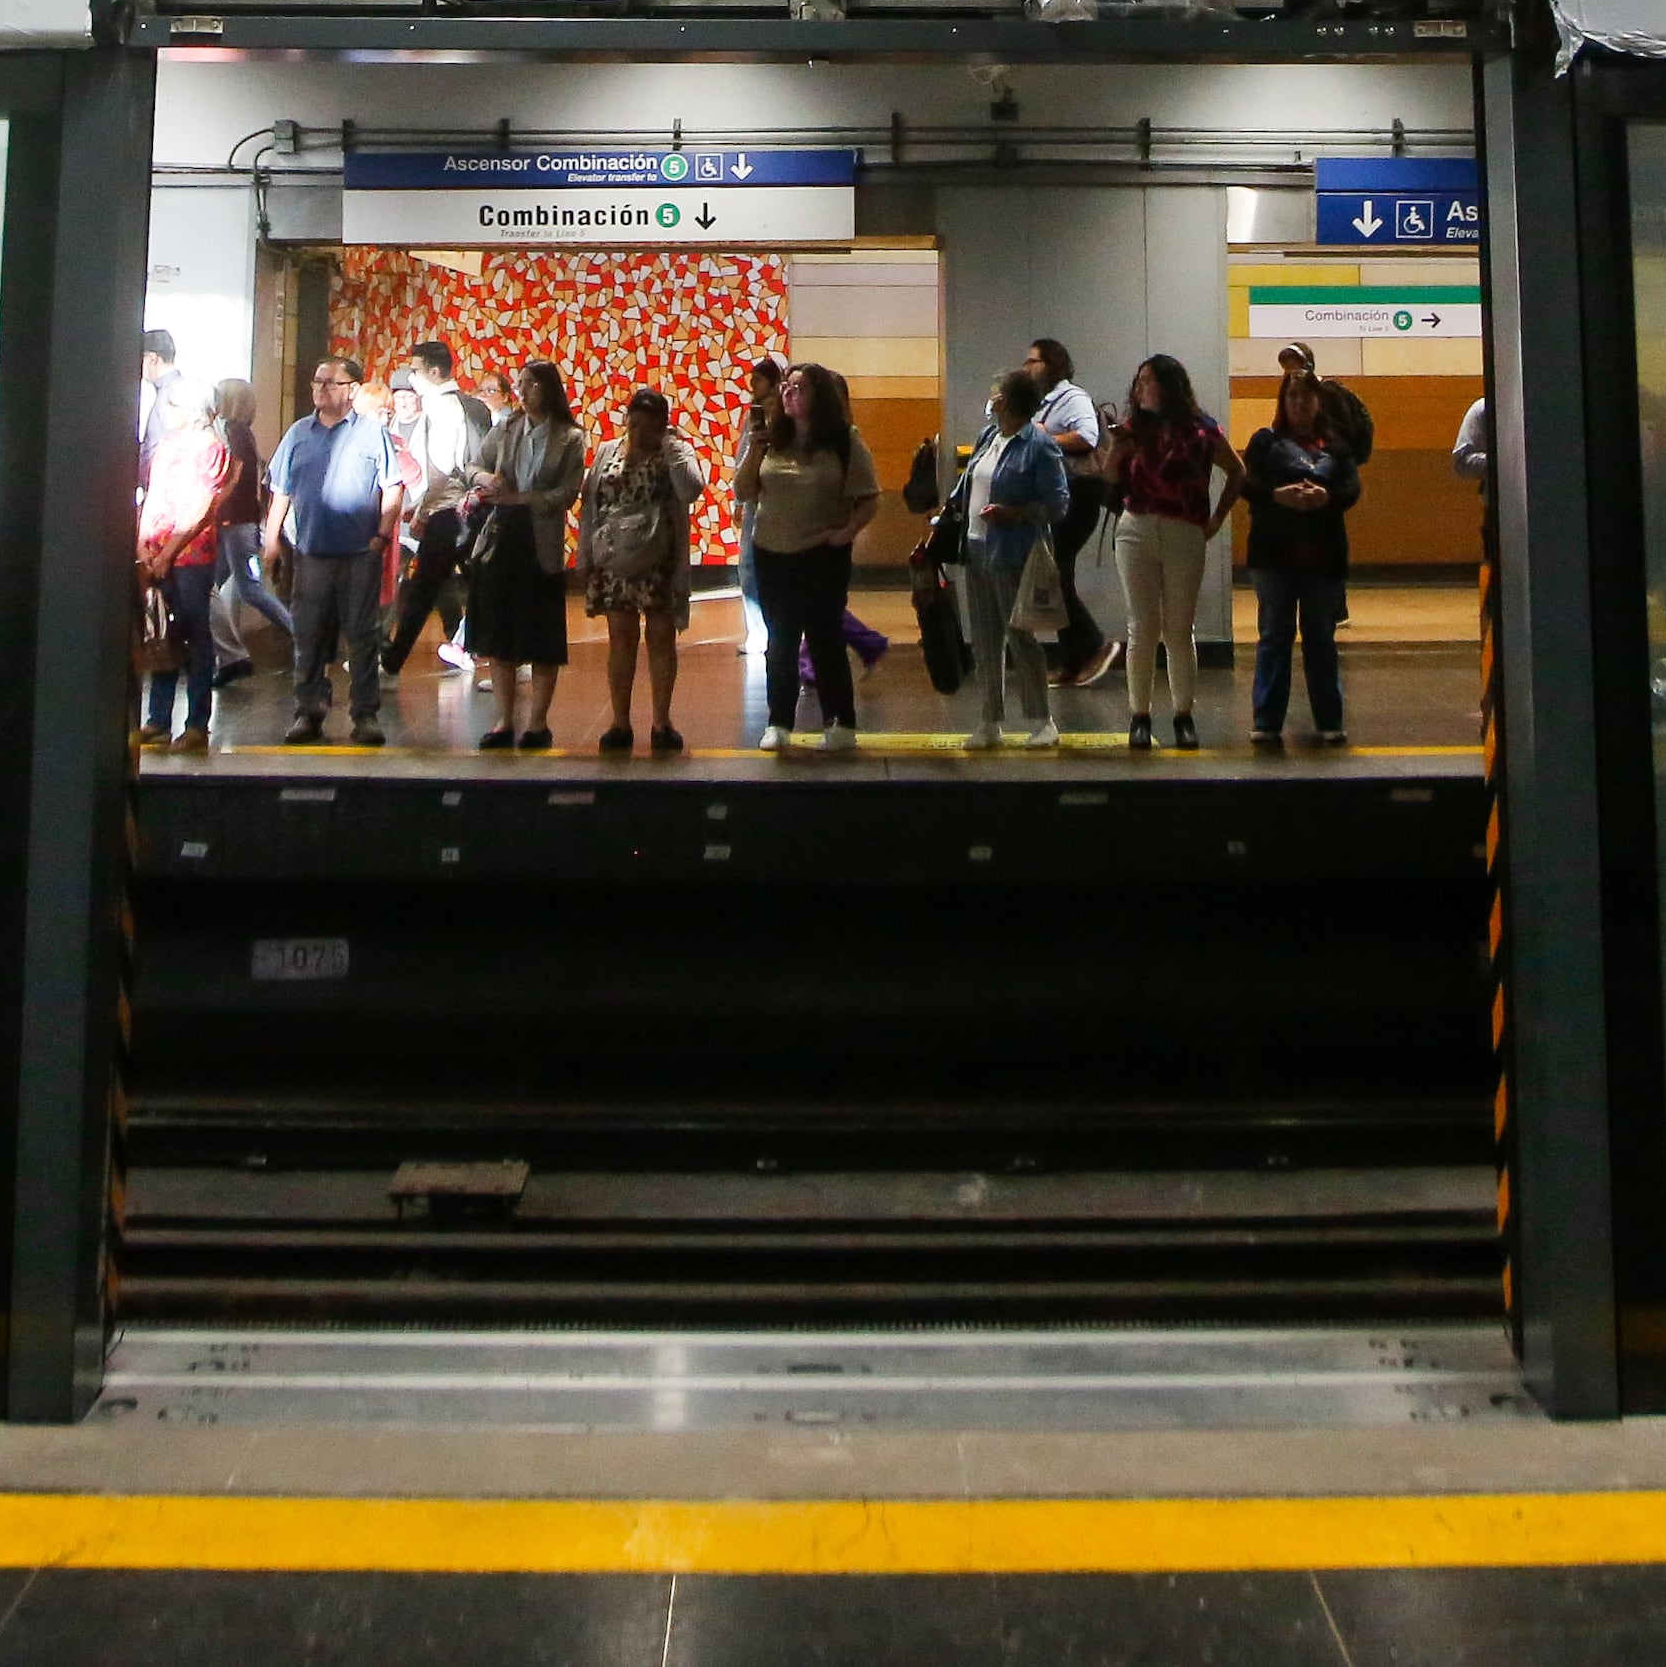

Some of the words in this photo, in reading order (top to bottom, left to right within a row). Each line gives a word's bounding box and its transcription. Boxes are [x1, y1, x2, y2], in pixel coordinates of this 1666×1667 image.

[443, 156, 531, 171] Ascensor
[536, 154, 658, 171] Combinación
[567, 173, 606, 182] Elevator
[608, 173, 646, 182] transfer
[647, 173, 658, 182] to
[479, 204, 649, 226] Combinación
[662, 209, 674, 224] 5
[1305, 309, 1389, 321] Combinación
